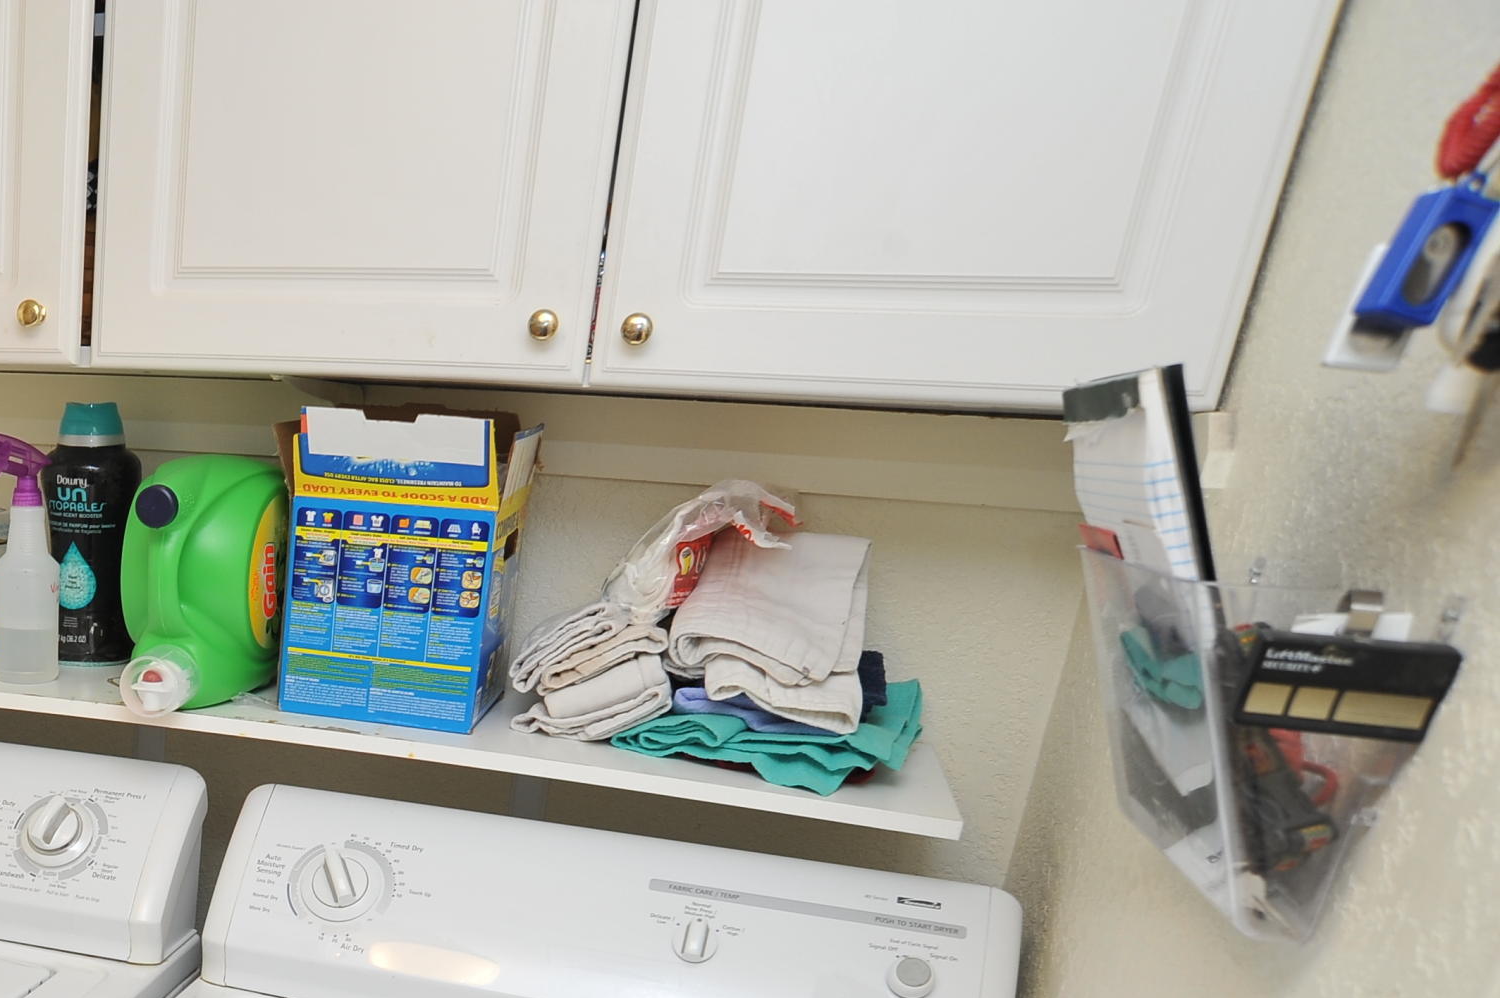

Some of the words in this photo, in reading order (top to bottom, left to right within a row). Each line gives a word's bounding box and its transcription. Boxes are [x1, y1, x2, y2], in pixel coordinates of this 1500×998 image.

[57, 474, 87, 488] Downy
[303, 483, 335, 493] LOAD
[339, 487, 378, 496] EVERY
[381, 490, 397, 498] TO
[401, 492, 444, 502] SCOOP
[461, 496, 489, 505] ADD
[262, 543, 276, 619] Gain
[94, 788, 125, 797] Permanent
[390, 841, 410, 850] Timed
[412, 845, 424, 853] Dry
[265, 853, 282, 861] Auto
[257, 859, 286, 869] Moisture
[92, 872, 117, 881] Delicate
[257, 867, 282, 877] Sensing
[669, 884, 693, 893] FABRIC
[695, 888, 713, 896] CARE
[720, 892, 740, 900] TEMP
[875, 916, 894, 924] PUSH
[909, 922, 933, 930] START
[934, 925, 959, 935] DRYER
[353, 945, 364, 954] Dry
